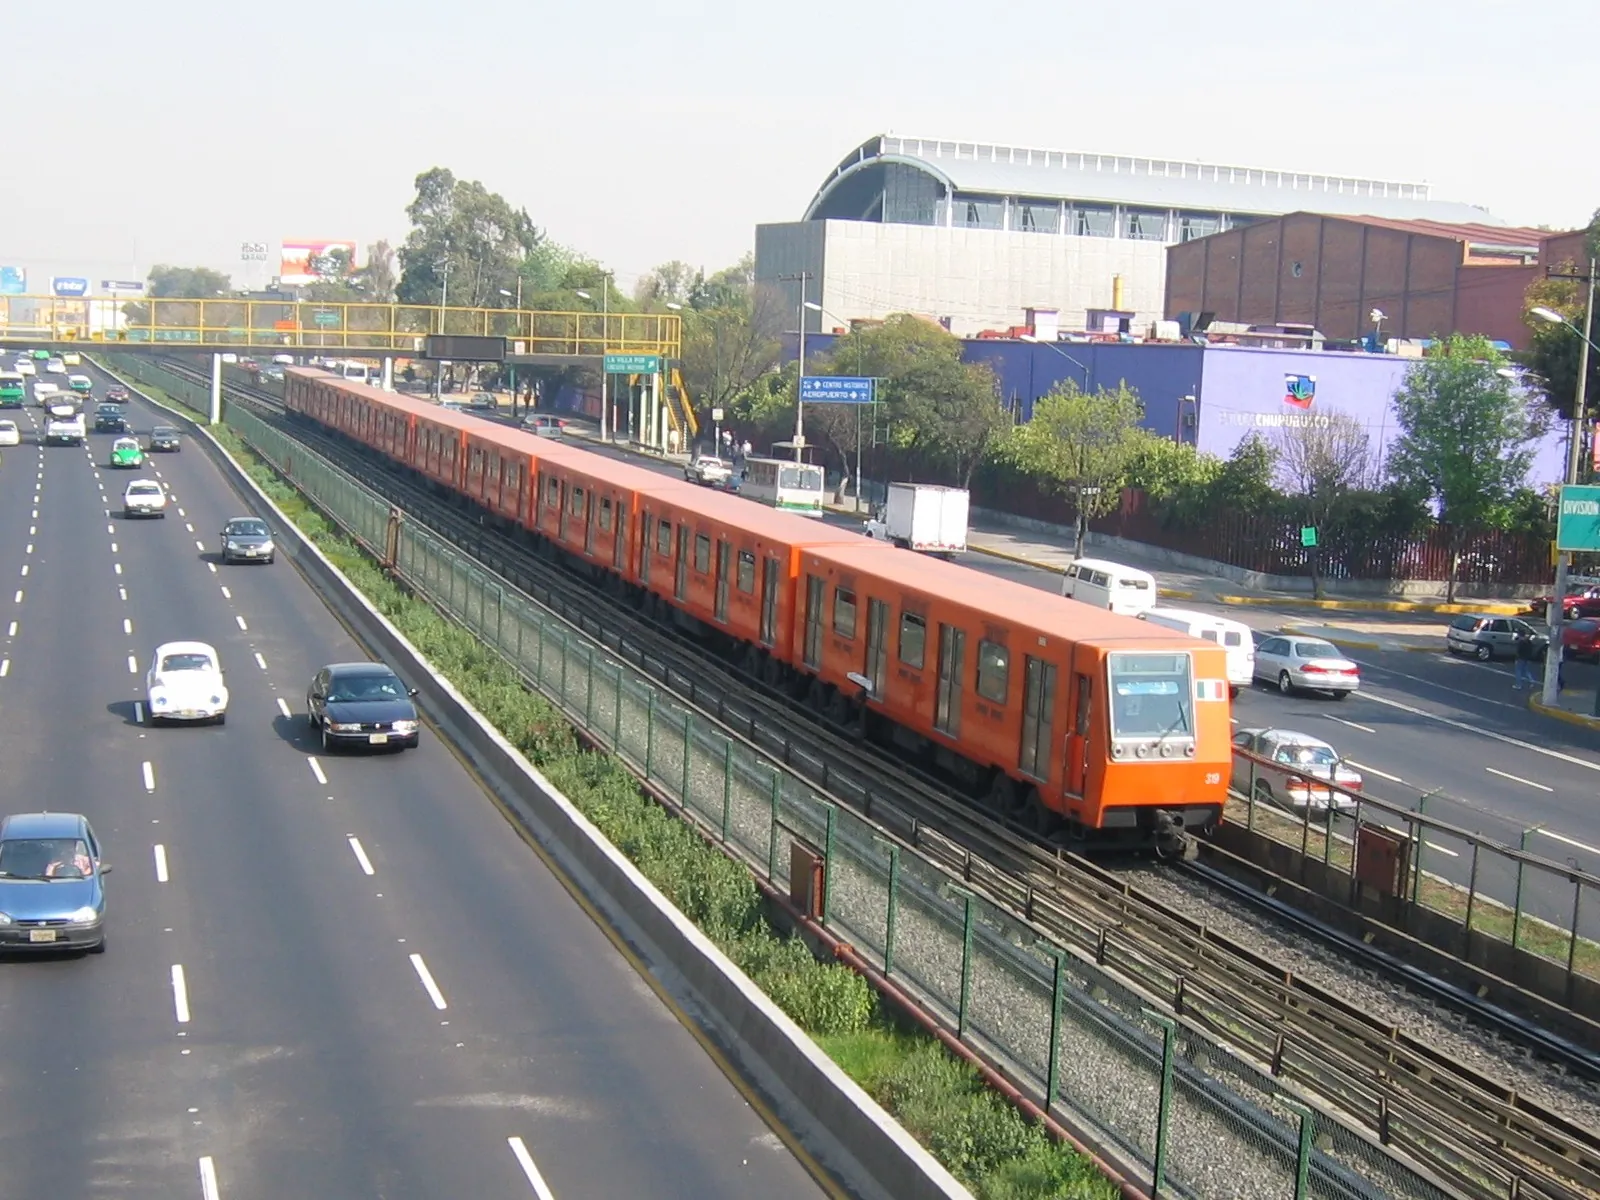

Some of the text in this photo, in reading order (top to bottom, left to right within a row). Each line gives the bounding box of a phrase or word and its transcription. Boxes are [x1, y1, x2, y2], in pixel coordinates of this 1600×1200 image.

[241, 242, 269, 253] Hotel
[802, 390, 848, 398] AEROPUERTO
[1204, 772, 1220, 784] 319
